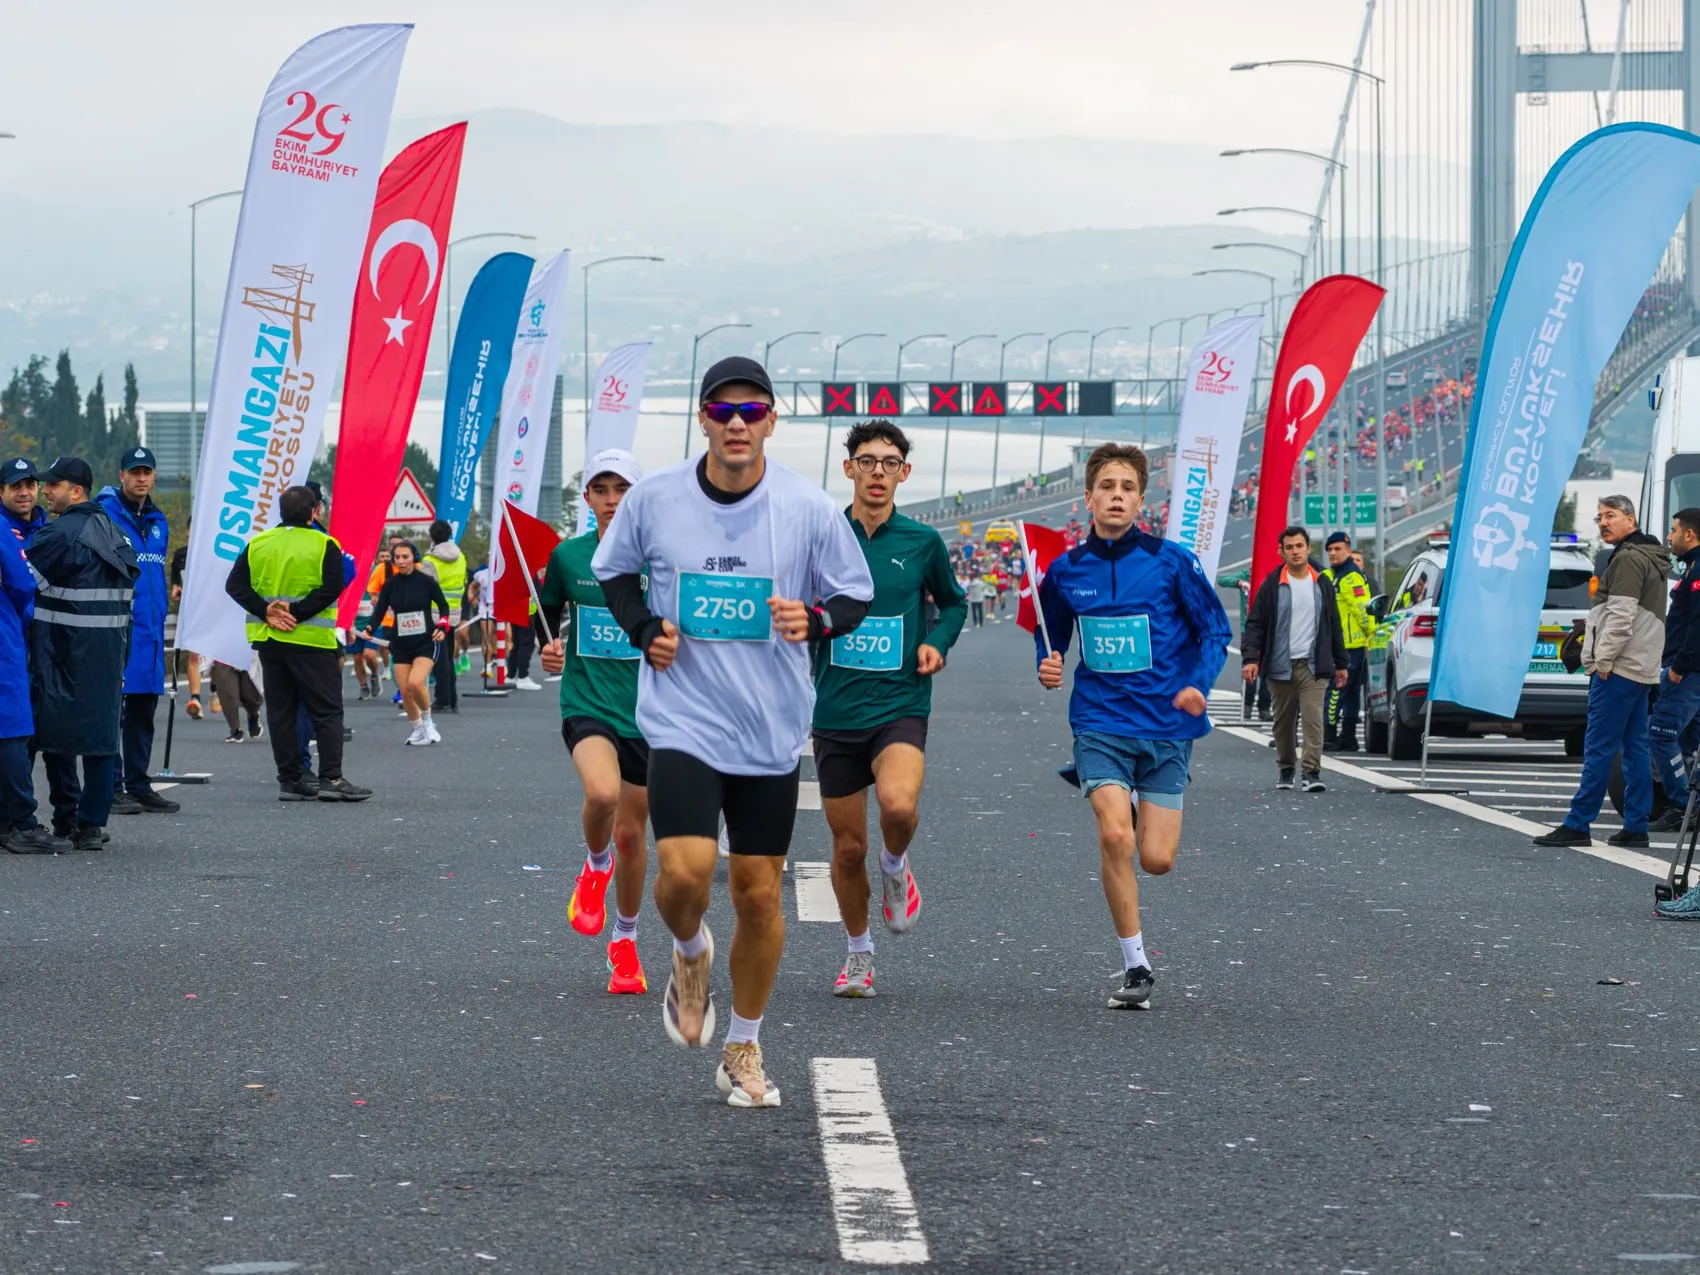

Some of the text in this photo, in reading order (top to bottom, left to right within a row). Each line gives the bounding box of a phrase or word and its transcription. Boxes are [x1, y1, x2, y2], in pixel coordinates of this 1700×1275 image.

[275, 138, 307, 153] EKİM
[271, 160, 330, 182] BAYRAMI
[273, 149, 358, 177] CUMHURİYET
[213, 322, 291, 562] OSMANGAZİ
[693, 596, 756, 620] 2750
[844, 634, 891, 653] 3570
[1093, 636, 1136, 655] 3571
